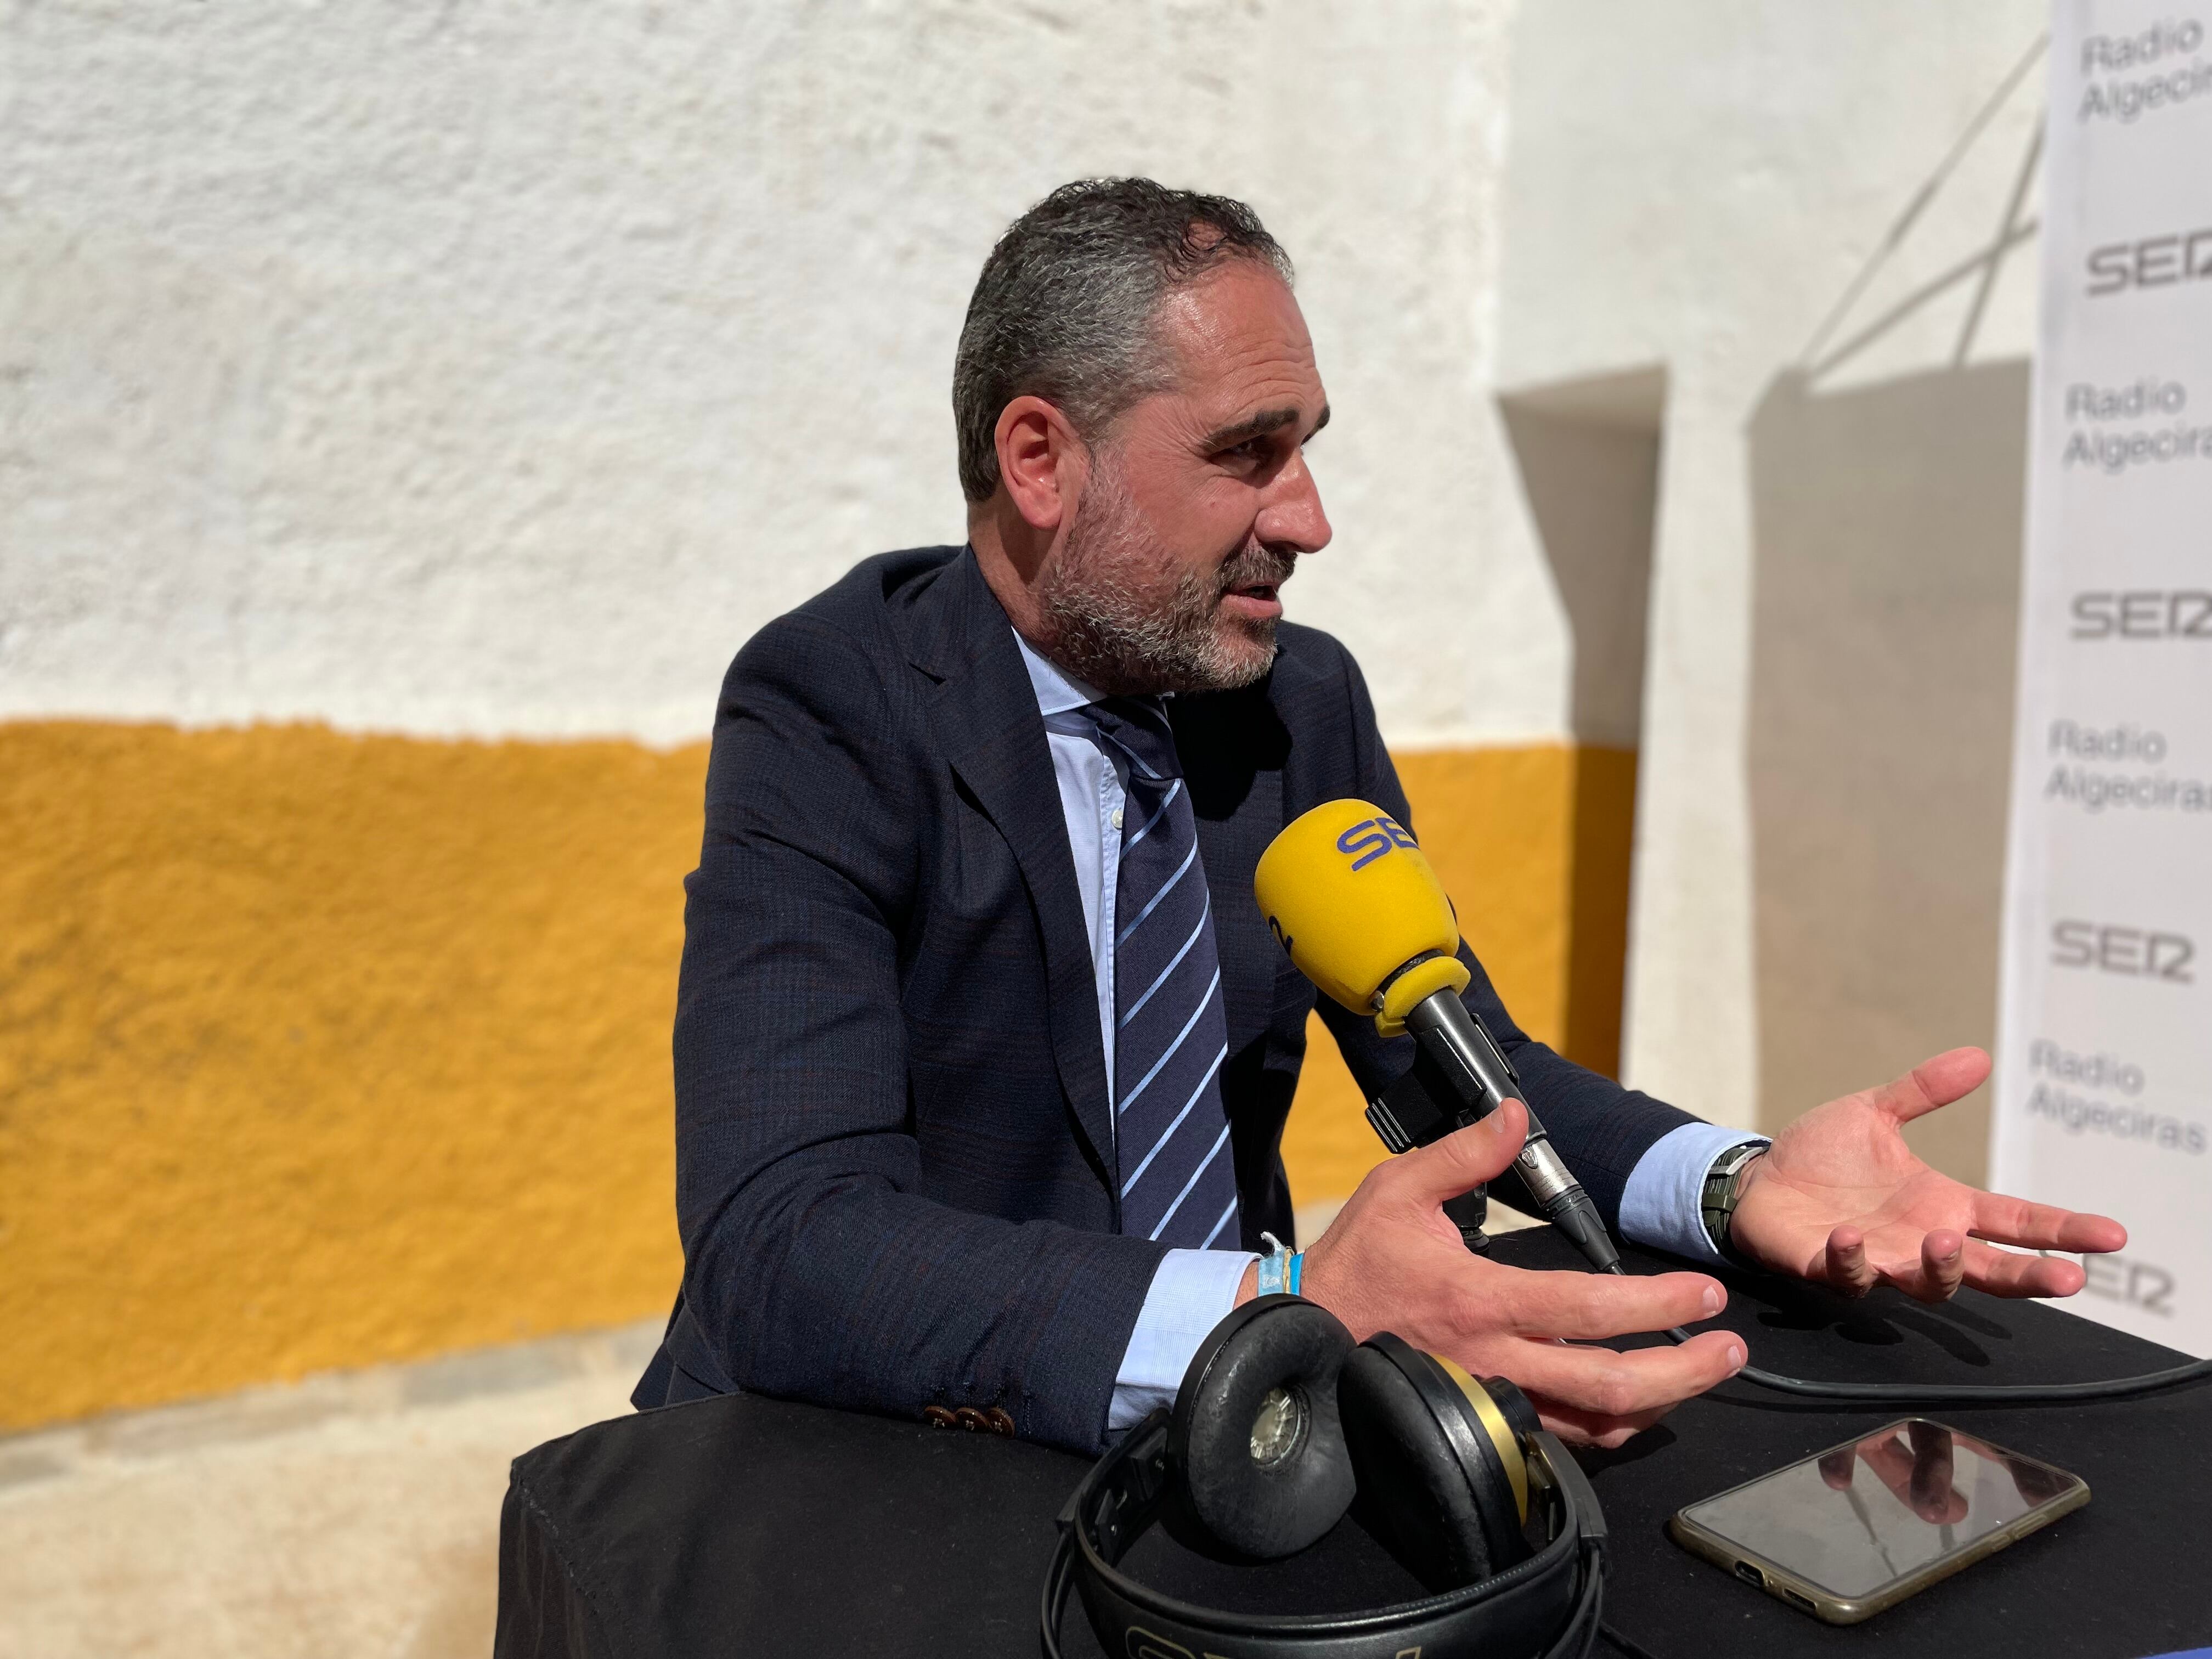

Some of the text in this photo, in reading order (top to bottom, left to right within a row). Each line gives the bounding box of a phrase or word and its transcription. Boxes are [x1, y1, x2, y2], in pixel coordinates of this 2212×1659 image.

[2081, 19, 2203, 78] Radio
[2064, 375, 2186, 424] Radio
[2070, 591, 2212, 640] SER
[2047, 718, 2168, 764] Radio
[2051, 920, 2196, 985] SER
[2030, 1039, 2145, 1097] Radio
[2025, 1080, 2207, 1155] Algeciras
[2039, 1250, 2177, 1318] ER
